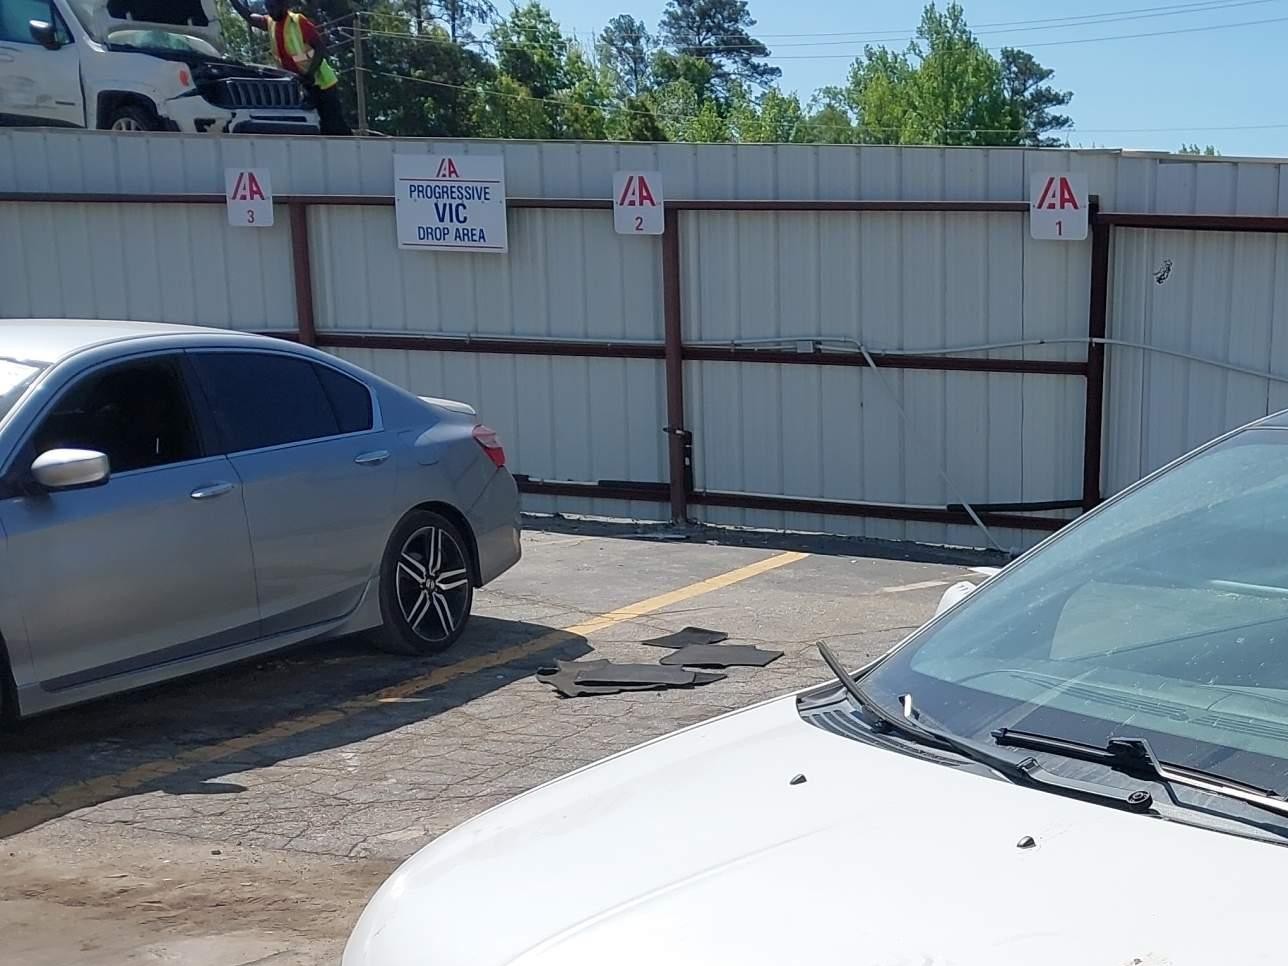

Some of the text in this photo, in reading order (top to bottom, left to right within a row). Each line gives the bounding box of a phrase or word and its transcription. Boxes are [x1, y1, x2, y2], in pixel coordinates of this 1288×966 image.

[409, 184, 490, 200] PROGRESSIVE
[247, 209, 255, 223] 3
[434, 202, 468, 224] VIC
[635, 216, 644, 231] 2
[1055, 220, 1063, 236] 1
[418, 226, 486, 242] DROP AREA
